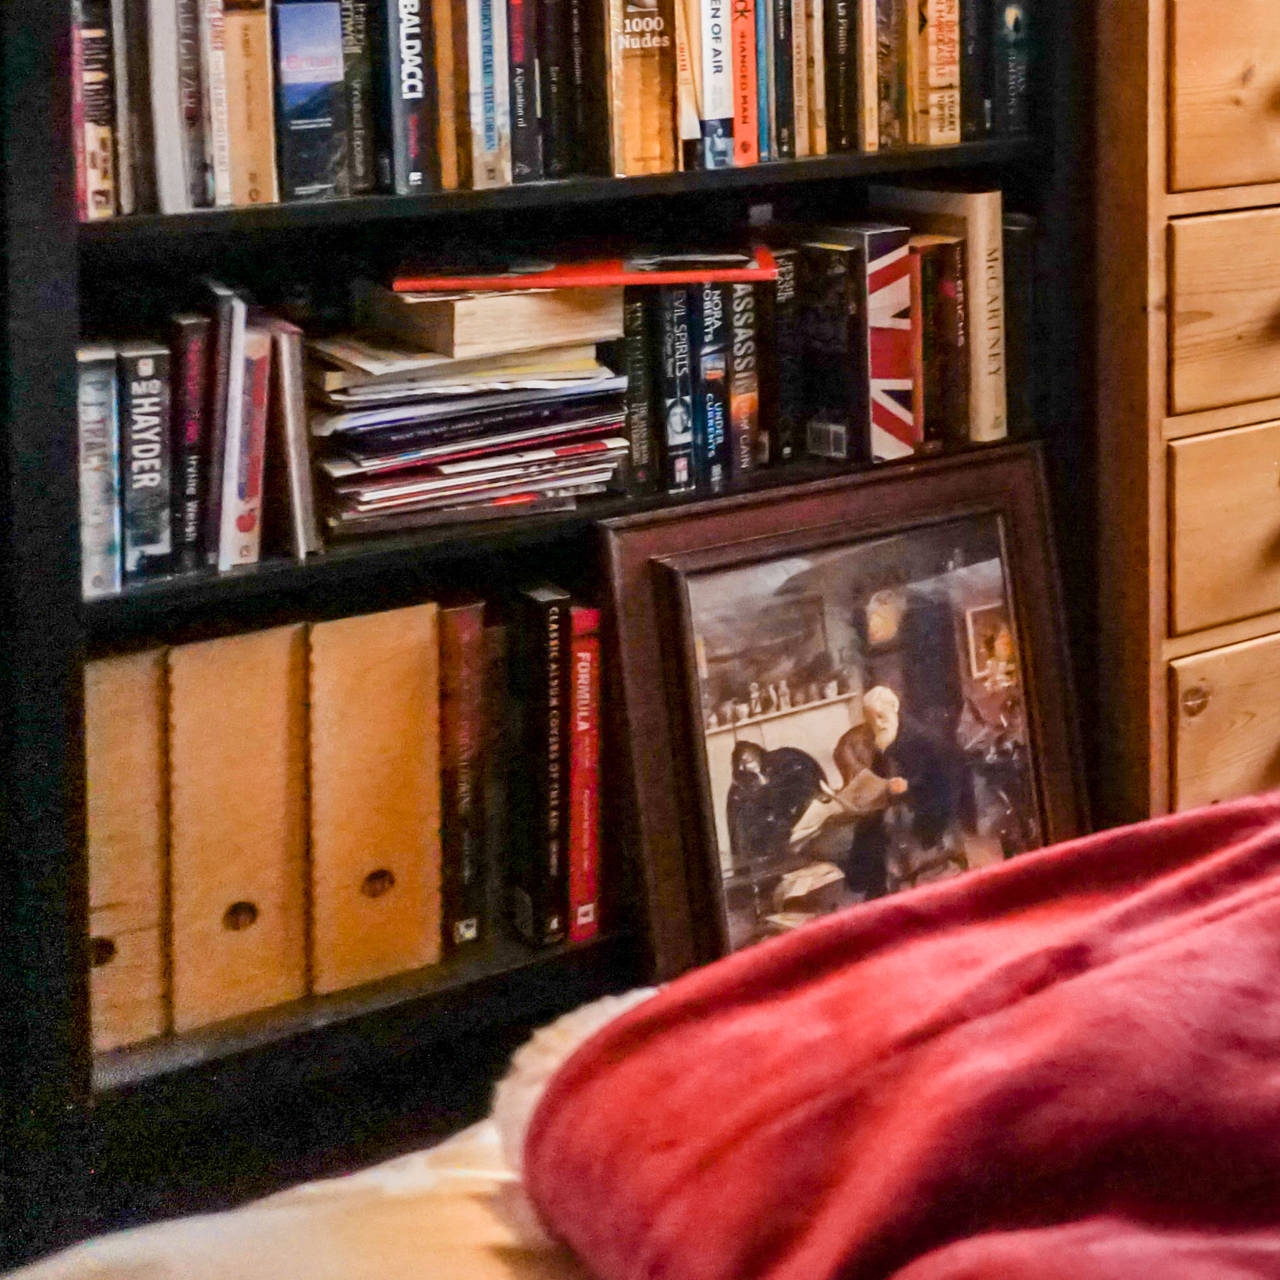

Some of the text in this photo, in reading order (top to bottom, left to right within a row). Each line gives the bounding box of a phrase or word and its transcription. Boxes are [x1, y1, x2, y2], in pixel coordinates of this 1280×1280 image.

[624, 16, 665, 33] 1000
[837, 2, 847, 17] La
[398, 0, 424, 100] BALDACCI
[617, 33, 670, 49] Nudes
[710, 23, 722, 44] OF
[837, 18, 849, 55] Plante
[482, 45, 494, 77] PEAKE
[711, 47, 723, 75] AIR
[513, 67, 525, 116] A Question
[741, 95, 750, 125] MAN
[712, 289, 722, 329] NORA
[985, 247, 1001, 378] McCARTNEY
[674, 323, 689, 377] SPIRITS
[731, 283, 758, 396] ASSASSIN
[131, 396, 162, 489] HAYDER
[705, 393, 716, 458] CURRENTS
[714, 401, 724, 445] UNDER
[739, 434, 750, 469] CAIN
[549, 662, 559, 708] ALBUM
[576, 651, 591, 731] FORMULA
[549, 710, 559, 760] COVERS
[549, 762, 559, 780] OF
[549, 783, 559, 806] THE
